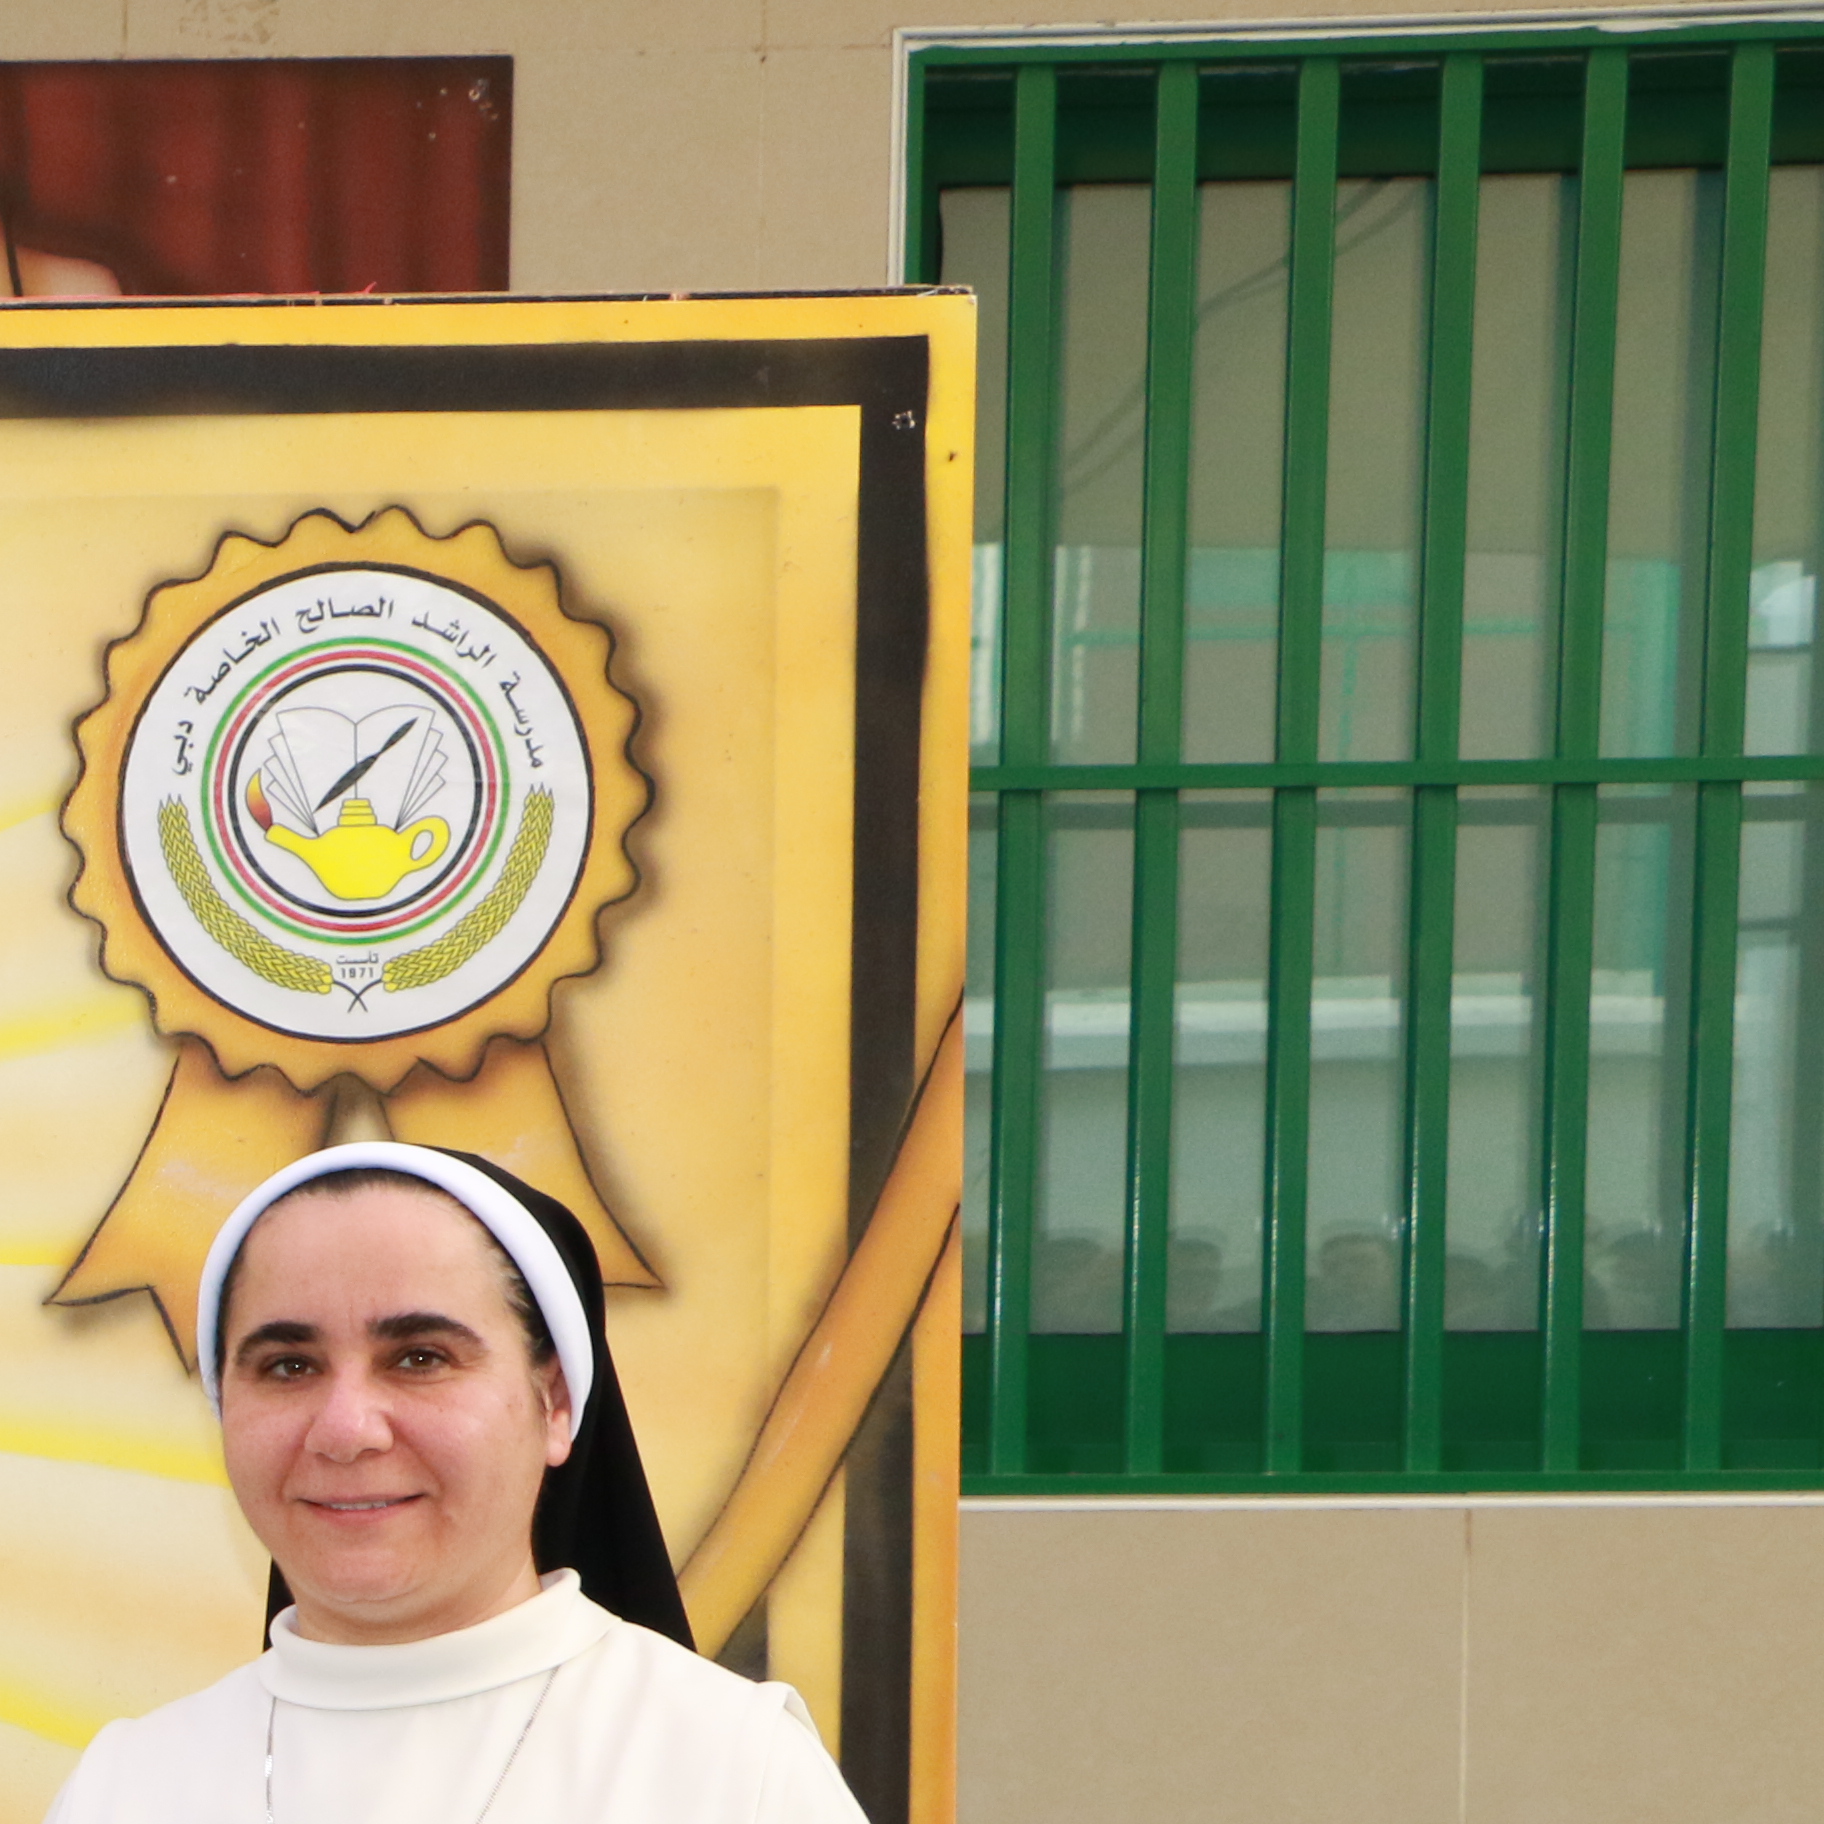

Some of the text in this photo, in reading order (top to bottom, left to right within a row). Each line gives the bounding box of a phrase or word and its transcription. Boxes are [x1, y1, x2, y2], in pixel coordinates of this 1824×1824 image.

[171, 597, 546, 777] مدرسة الراشد الصالح الخاصة دبي
[341, 967, 374, 979] 1971
